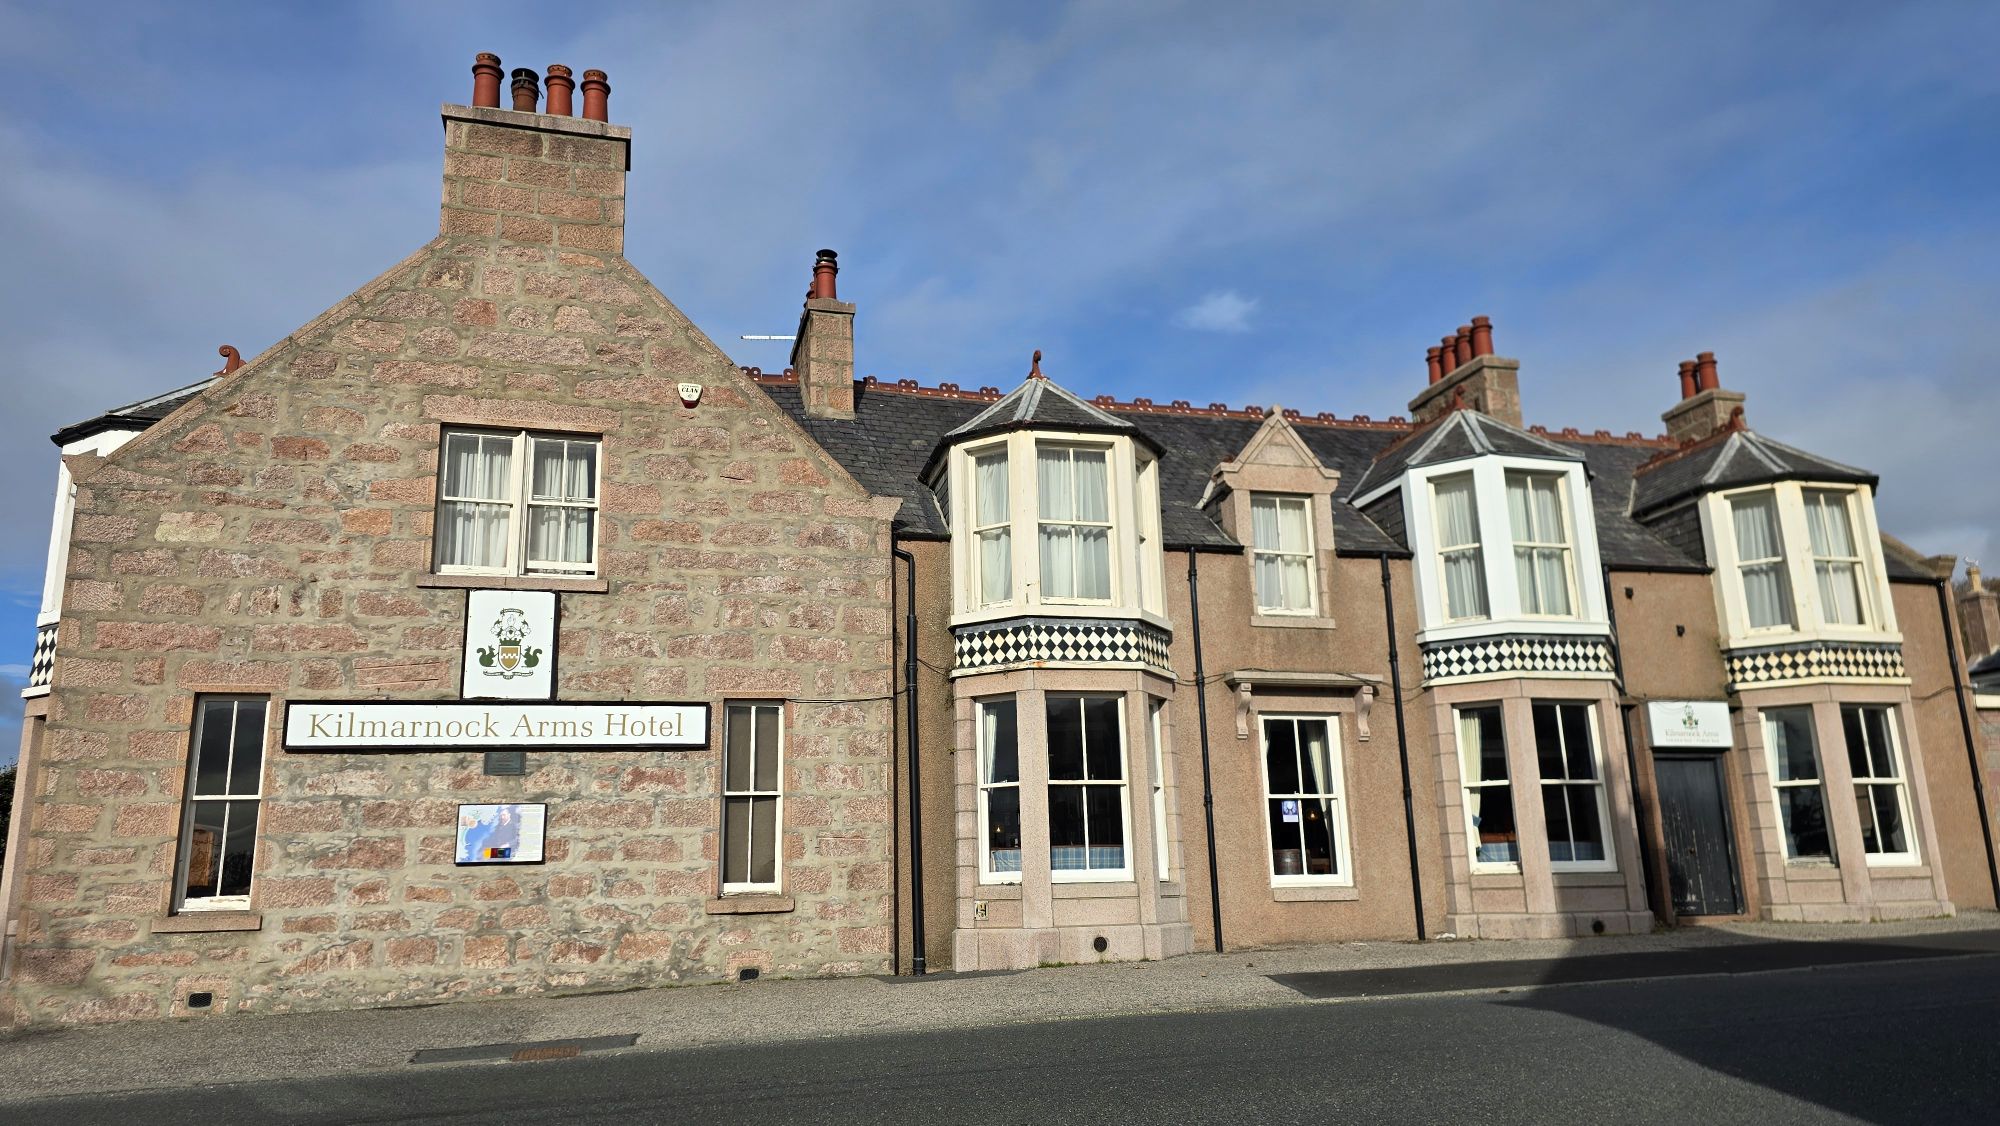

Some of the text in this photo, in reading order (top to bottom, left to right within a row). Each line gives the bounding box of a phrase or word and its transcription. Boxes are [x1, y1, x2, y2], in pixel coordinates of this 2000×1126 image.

[307, 711, 684, 738] Kilmarnock Arms Hotel
